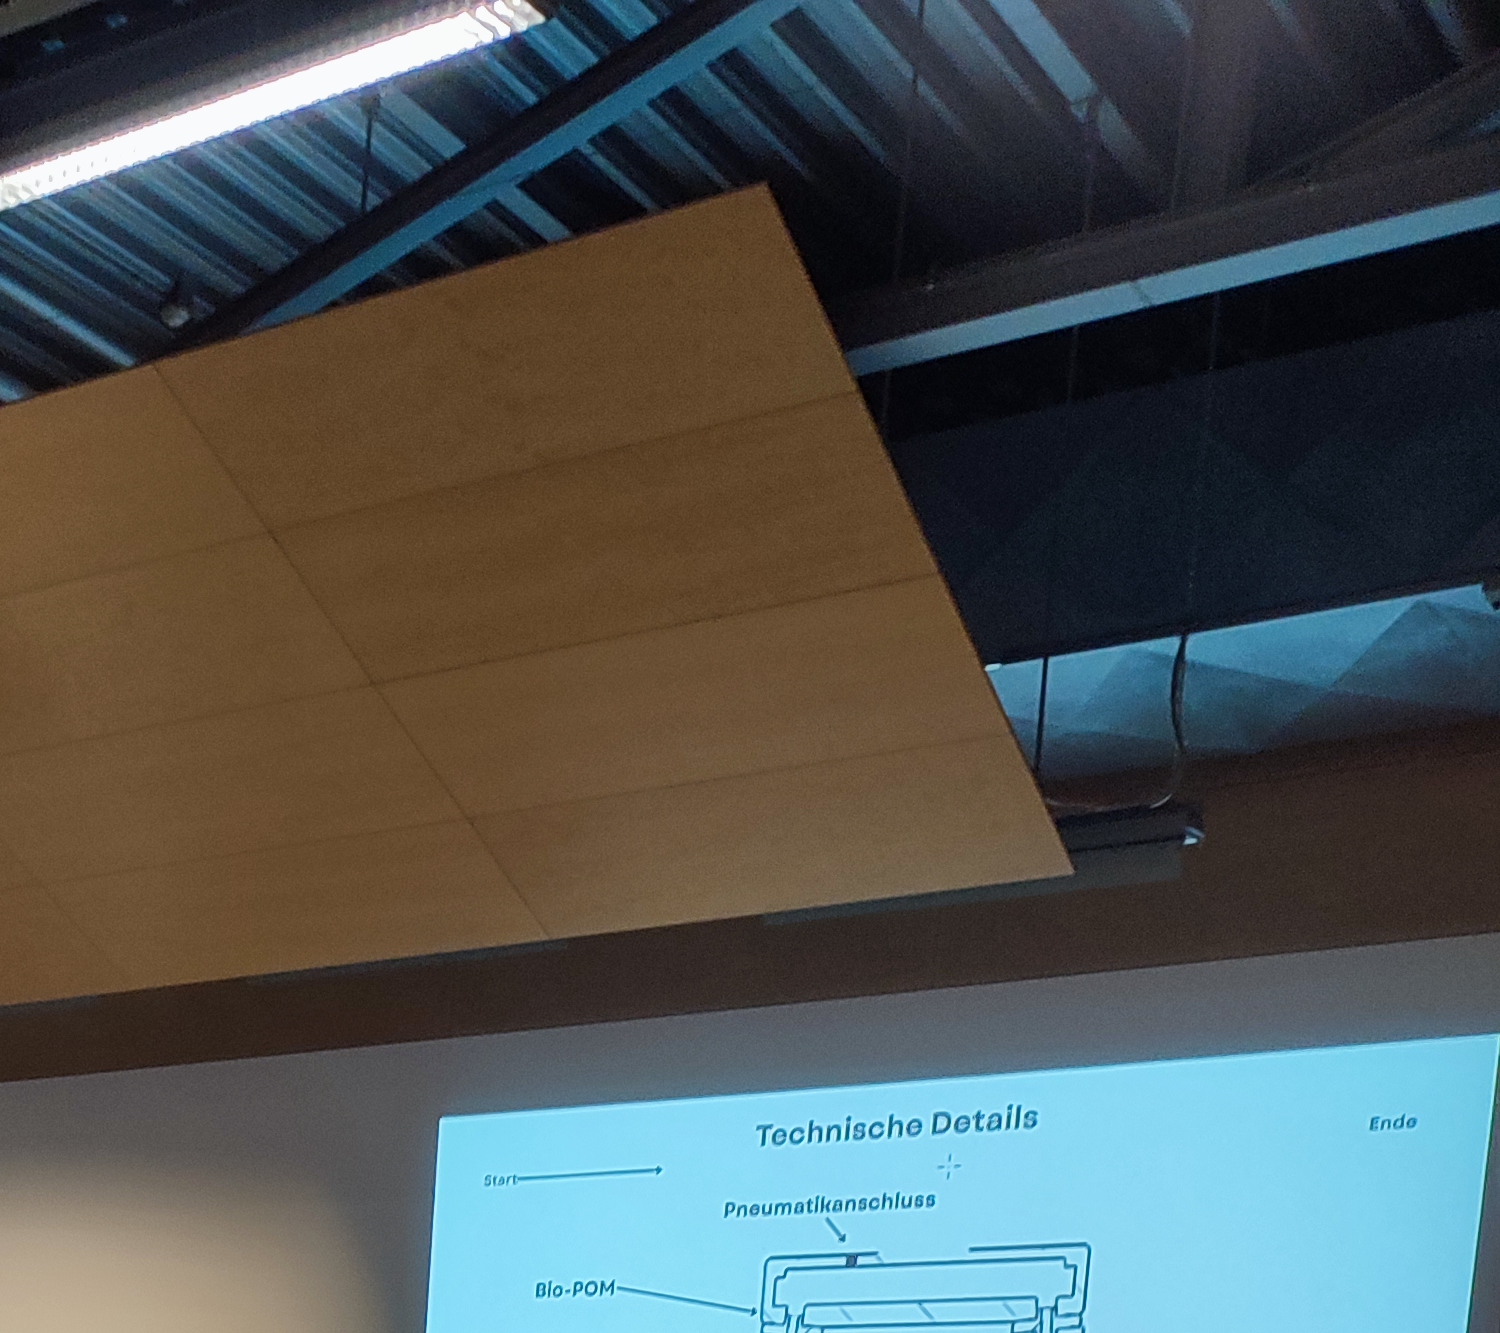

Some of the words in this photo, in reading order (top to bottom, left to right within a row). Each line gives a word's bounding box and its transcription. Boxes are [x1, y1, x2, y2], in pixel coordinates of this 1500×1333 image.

[756, 1113, 923, 1147] Technische
[931, 1103, 1039, 1136] Details
[484, 1173, 518, 1187] Start
[723, 1191, 936, 1218] Pneumatikanschluss
[535, 1279, 615, 1298] Bio-POM
